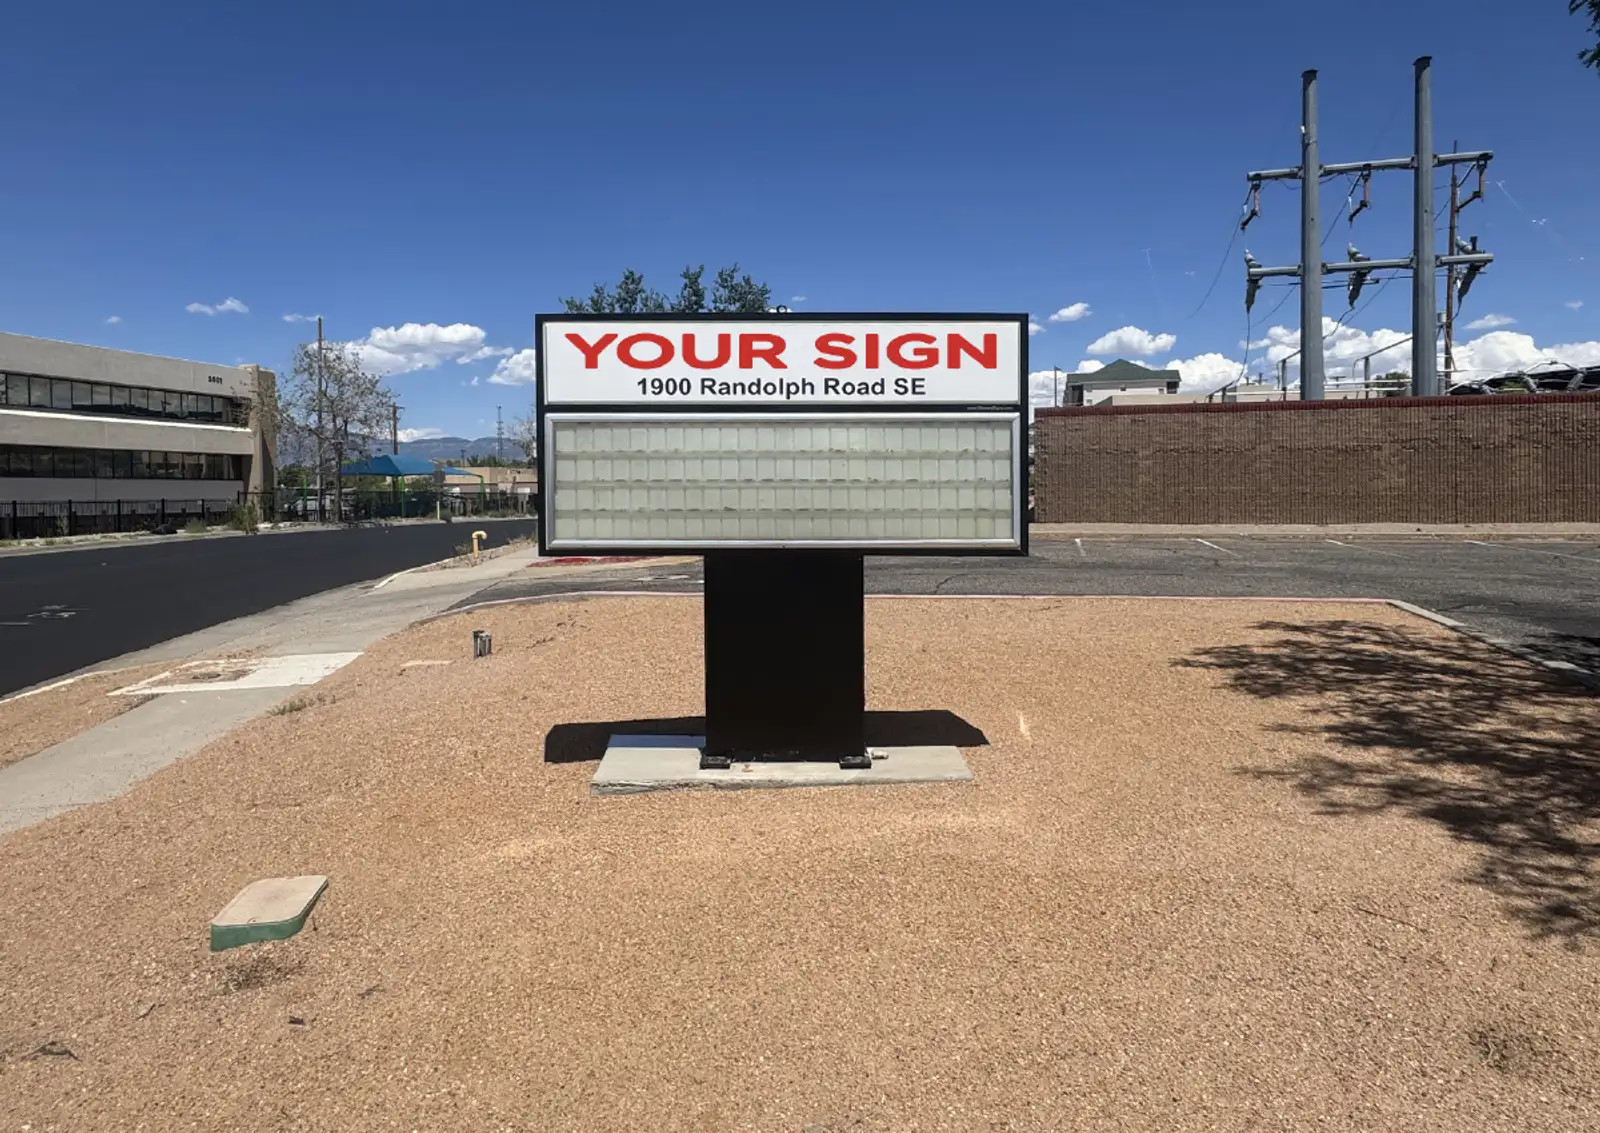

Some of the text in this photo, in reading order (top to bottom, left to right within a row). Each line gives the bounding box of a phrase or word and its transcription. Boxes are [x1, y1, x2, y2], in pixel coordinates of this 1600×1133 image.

[564, 332, 998, 370] YOUR SIGN
[637, 377, 926, 400] 1900 Randolph Road SE
